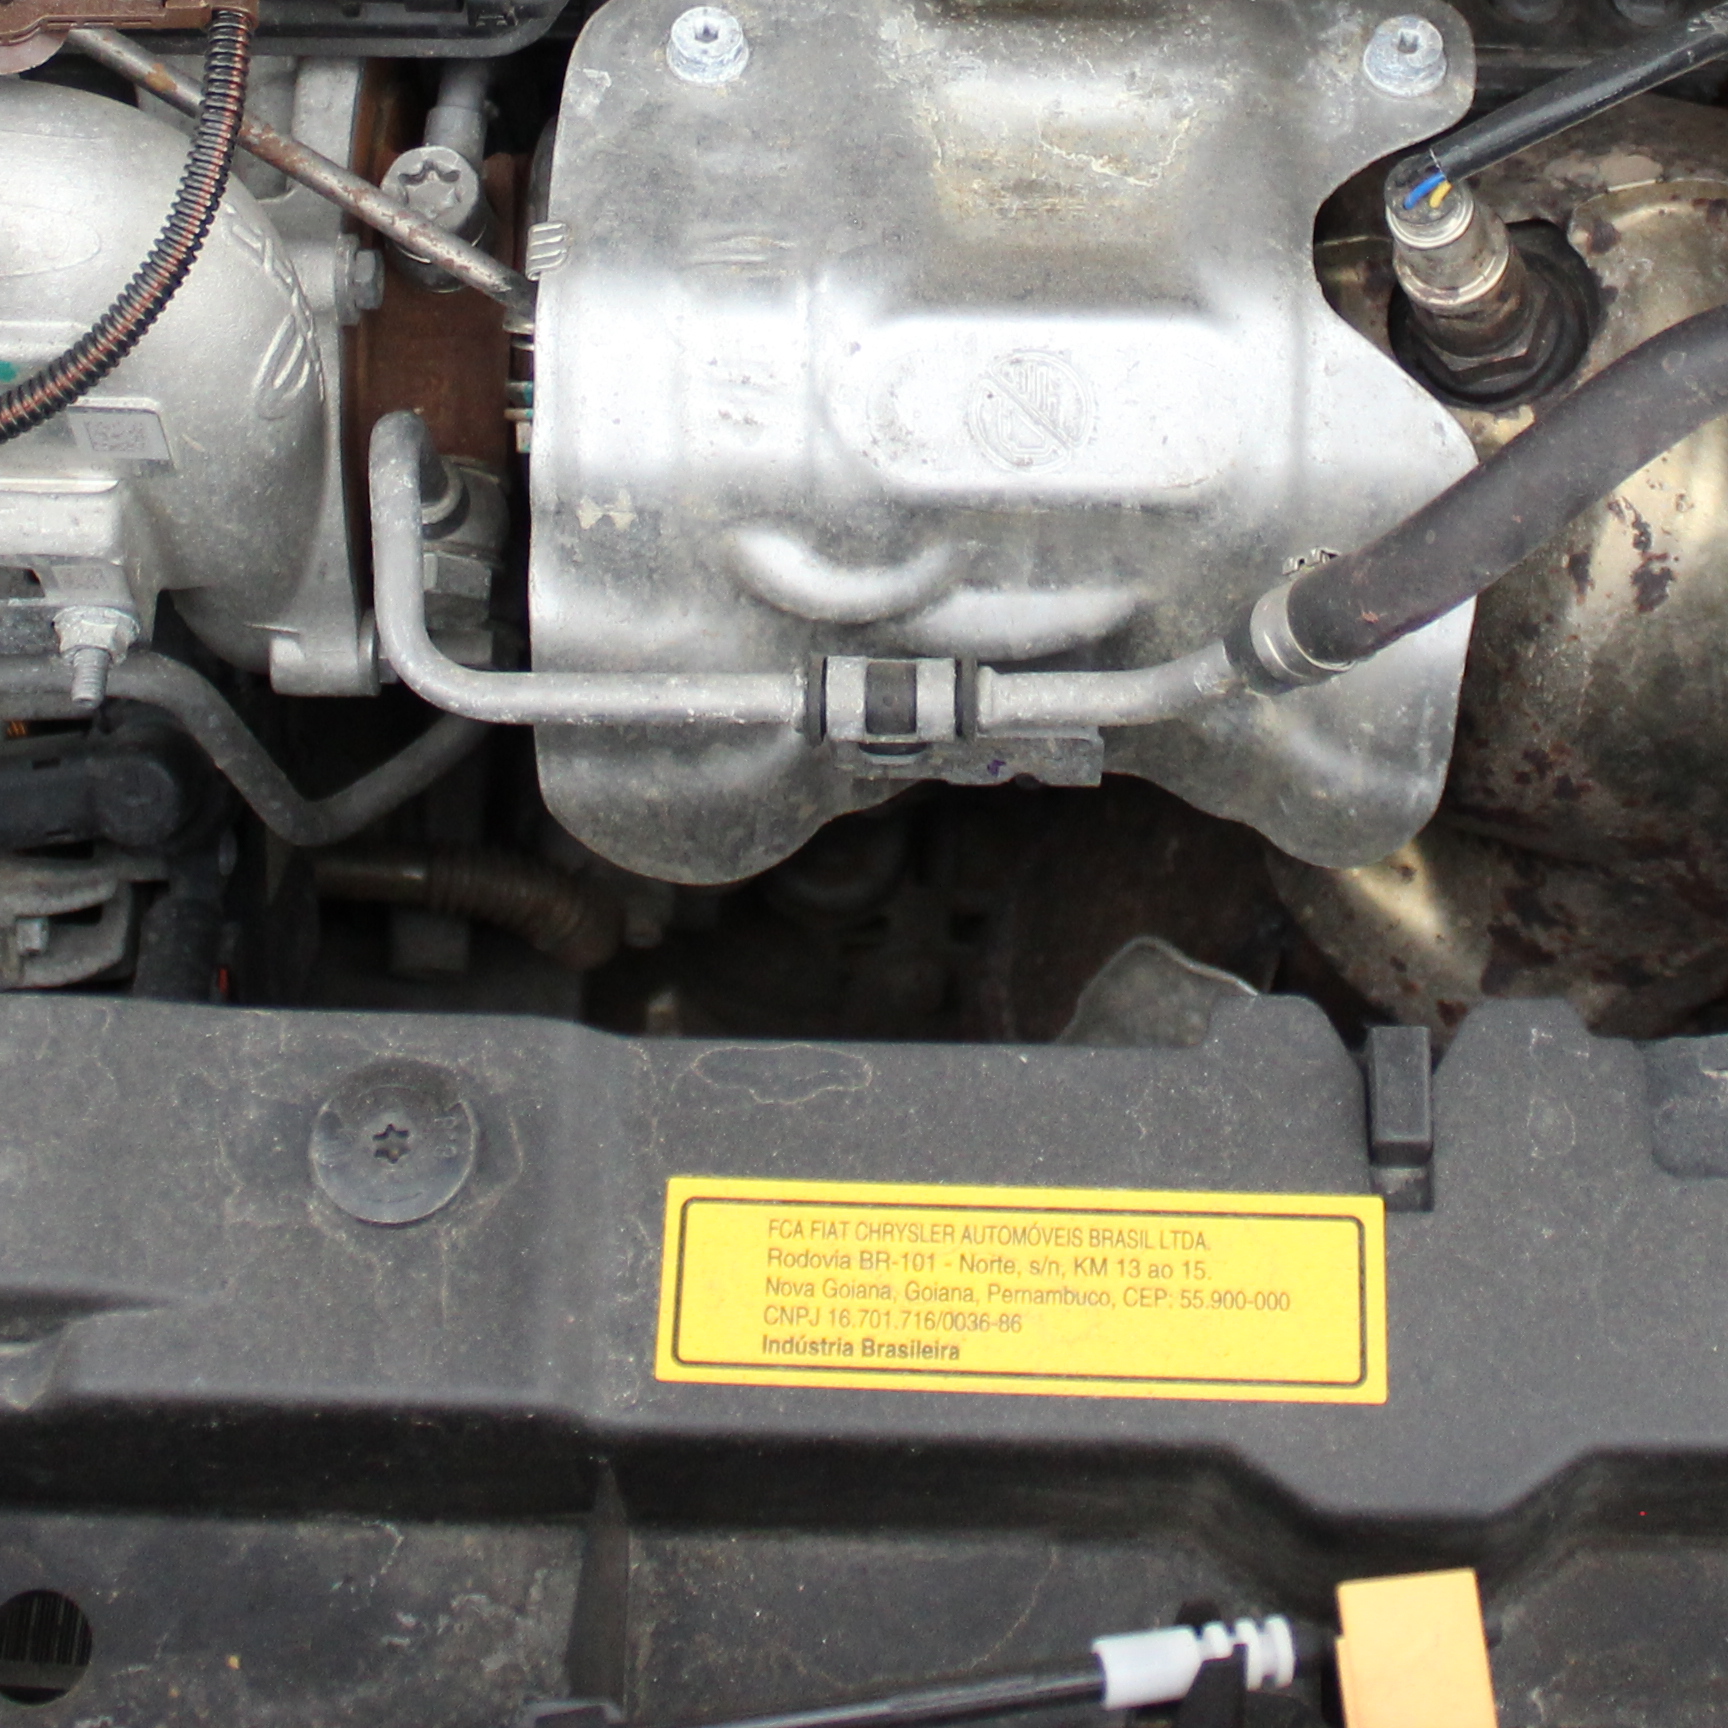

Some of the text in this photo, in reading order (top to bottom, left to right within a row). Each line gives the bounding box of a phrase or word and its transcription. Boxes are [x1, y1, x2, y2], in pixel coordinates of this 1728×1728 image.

[767, 1218, 1212, 1252] FCA FIAT CHRYSLER AUTOMÓVEIS BRASIL LTDA.
[767, 1247, 851, 1271] Rodovia
[858, 1250, 936, 1272] BR-101
[958, 1253, 1022, 1278] Norte,
[1028, 1256, 1066, 1280] s/n,
[1072, 1257, 1109, 1278] KM
[1116, 1258, 1142, 1279] 13
[1147, 1264, 1174, 1280] ao
[1182, 1261, 1213, 1281] 15.
[765, 1276, 1292, 1312] Nova Goiana, Goiana, Pernambuco, CEP: 55.900-000
[763, 1304, 1023, 1333] CNPJ 16.701.716/0036-86
[761, 1333, 961, 1361] Indústria Brasileira
